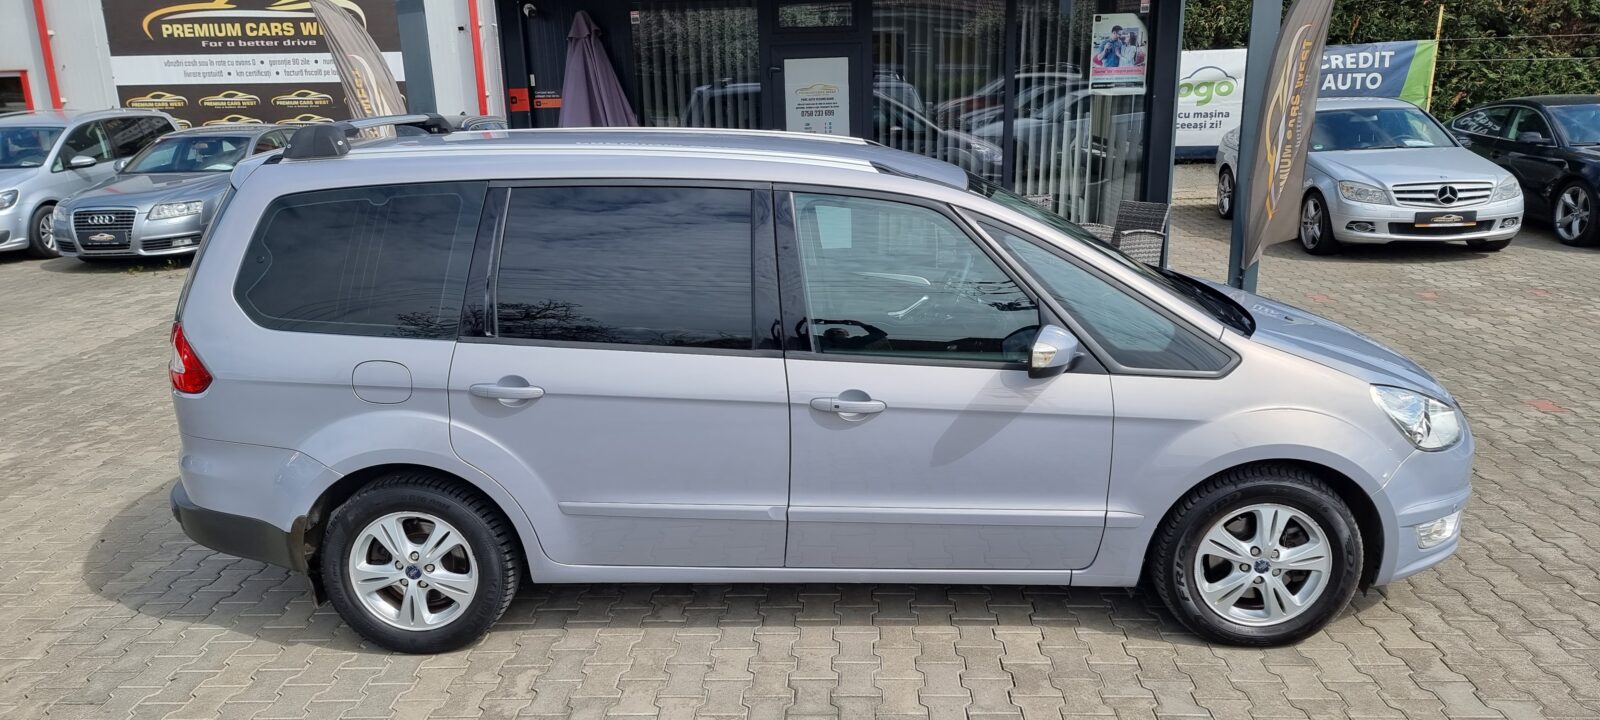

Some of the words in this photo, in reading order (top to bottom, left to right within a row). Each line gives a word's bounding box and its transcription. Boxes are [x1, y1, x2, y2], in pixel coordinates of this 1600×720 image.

[161, 24, 242, 38] PREMIUM
[246, 22, 295, 36] CARS
[238, 39, 279, 47] better
[1320, 51, 1394, 70] CREDIT
[1321, 72, 1382, 90] AUTO
[1193, 110, 1230, 120] mașina
[1209, 120, 1222, 128] zi!
